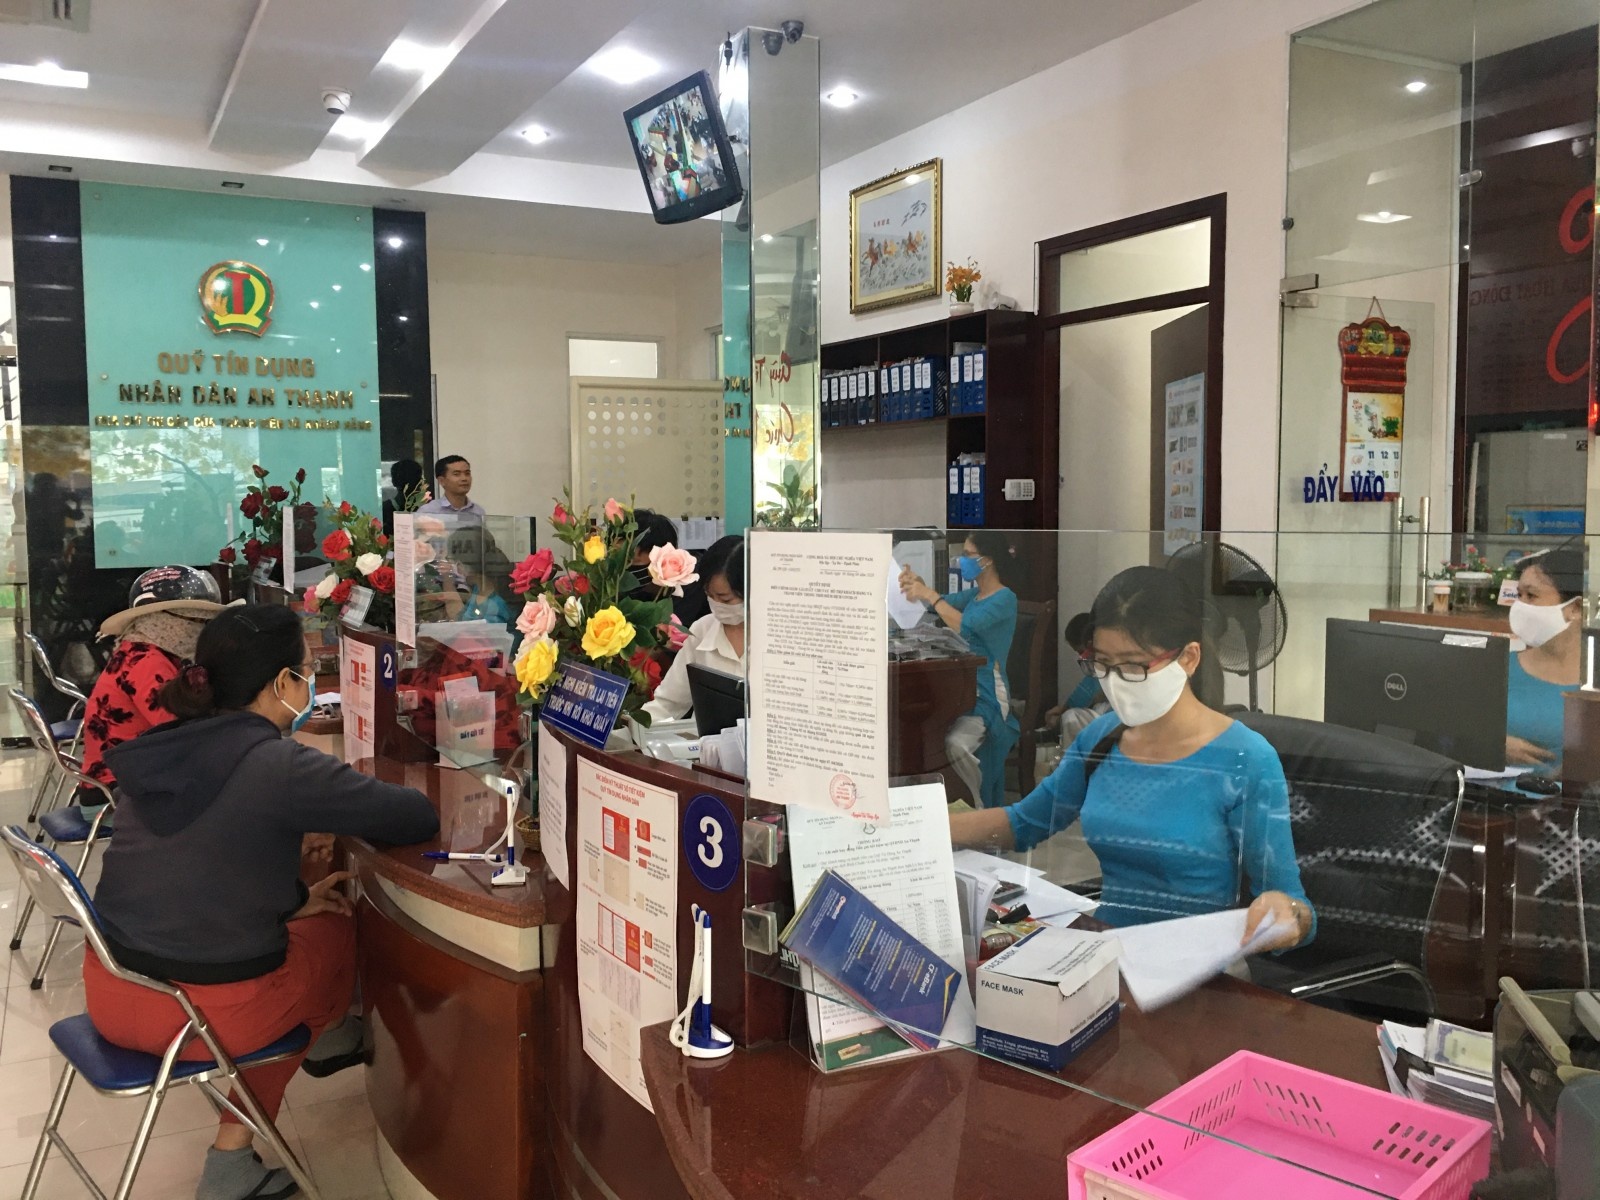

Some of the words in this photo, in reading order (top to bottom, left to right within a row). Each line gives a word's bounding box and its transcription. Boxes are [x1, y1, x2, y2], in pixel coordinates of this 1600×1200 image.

[158, 349, 205, 374] QUỸ
[212, 350, 249, 376] TÍN
[256, 356, 315, 381] DỤNG
[119, 380, 181, 405] NHÂN
[193, 382, 237, 406] DÂN
[248, 388, 275, 406] AN
[284, 388, 354, 413] THẠNH
[1381, 451, 1389, 459] 12
[1303, 462, 1338, 503] ĐẨY
[383, 653, 393, 679] 2
[1387, 682, 1404, 691] DELL
[698, 816, 724, 868] 3
[984, 957, 1002, 970] FACE
[1000, 949, 1019, 962] MASK
[981, 979, 1000, 991] FACE
[1002, 984, 1024, 996] MASK
